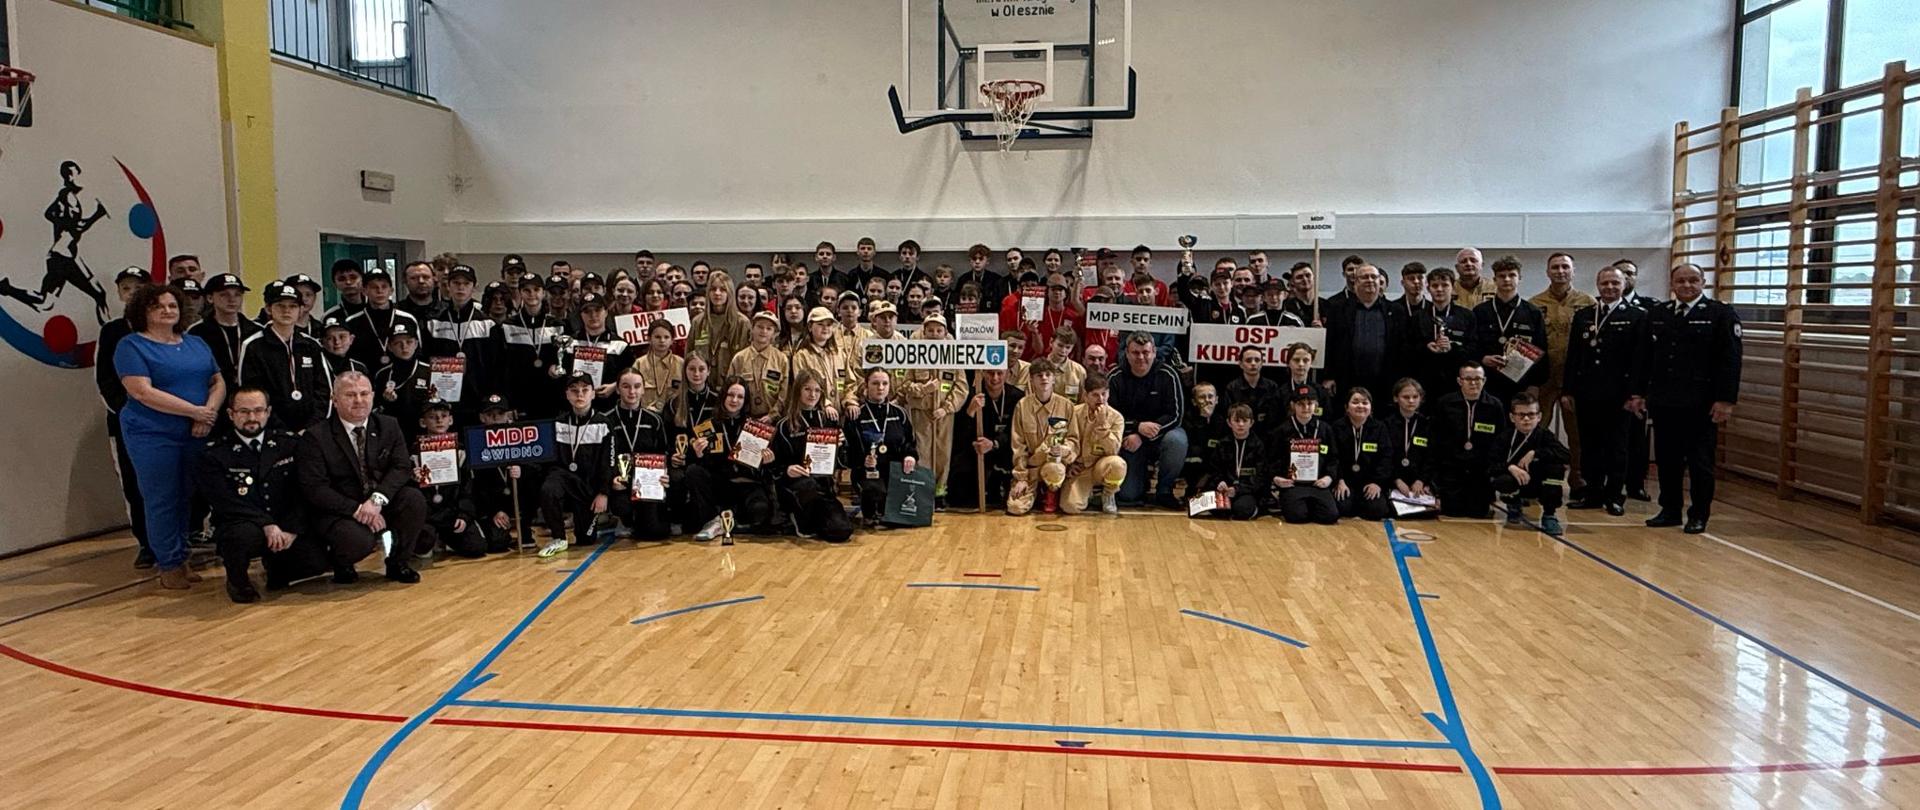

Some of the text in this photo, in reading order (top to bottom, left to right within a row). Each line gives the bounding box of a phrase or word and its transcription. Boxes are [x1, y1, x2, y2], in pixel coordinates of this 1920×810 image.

[1003, 5, 1054, 17] Olesznie
[1090, 311, 1184, 327] MDP SECEMIN
[960, 325, 995, 334] RADKÓW
[1235, 327, 1279, 344] OSP
[884, 343, 985, 365] DOBROMIERZ
[486, 426, 539, 447] MDP
